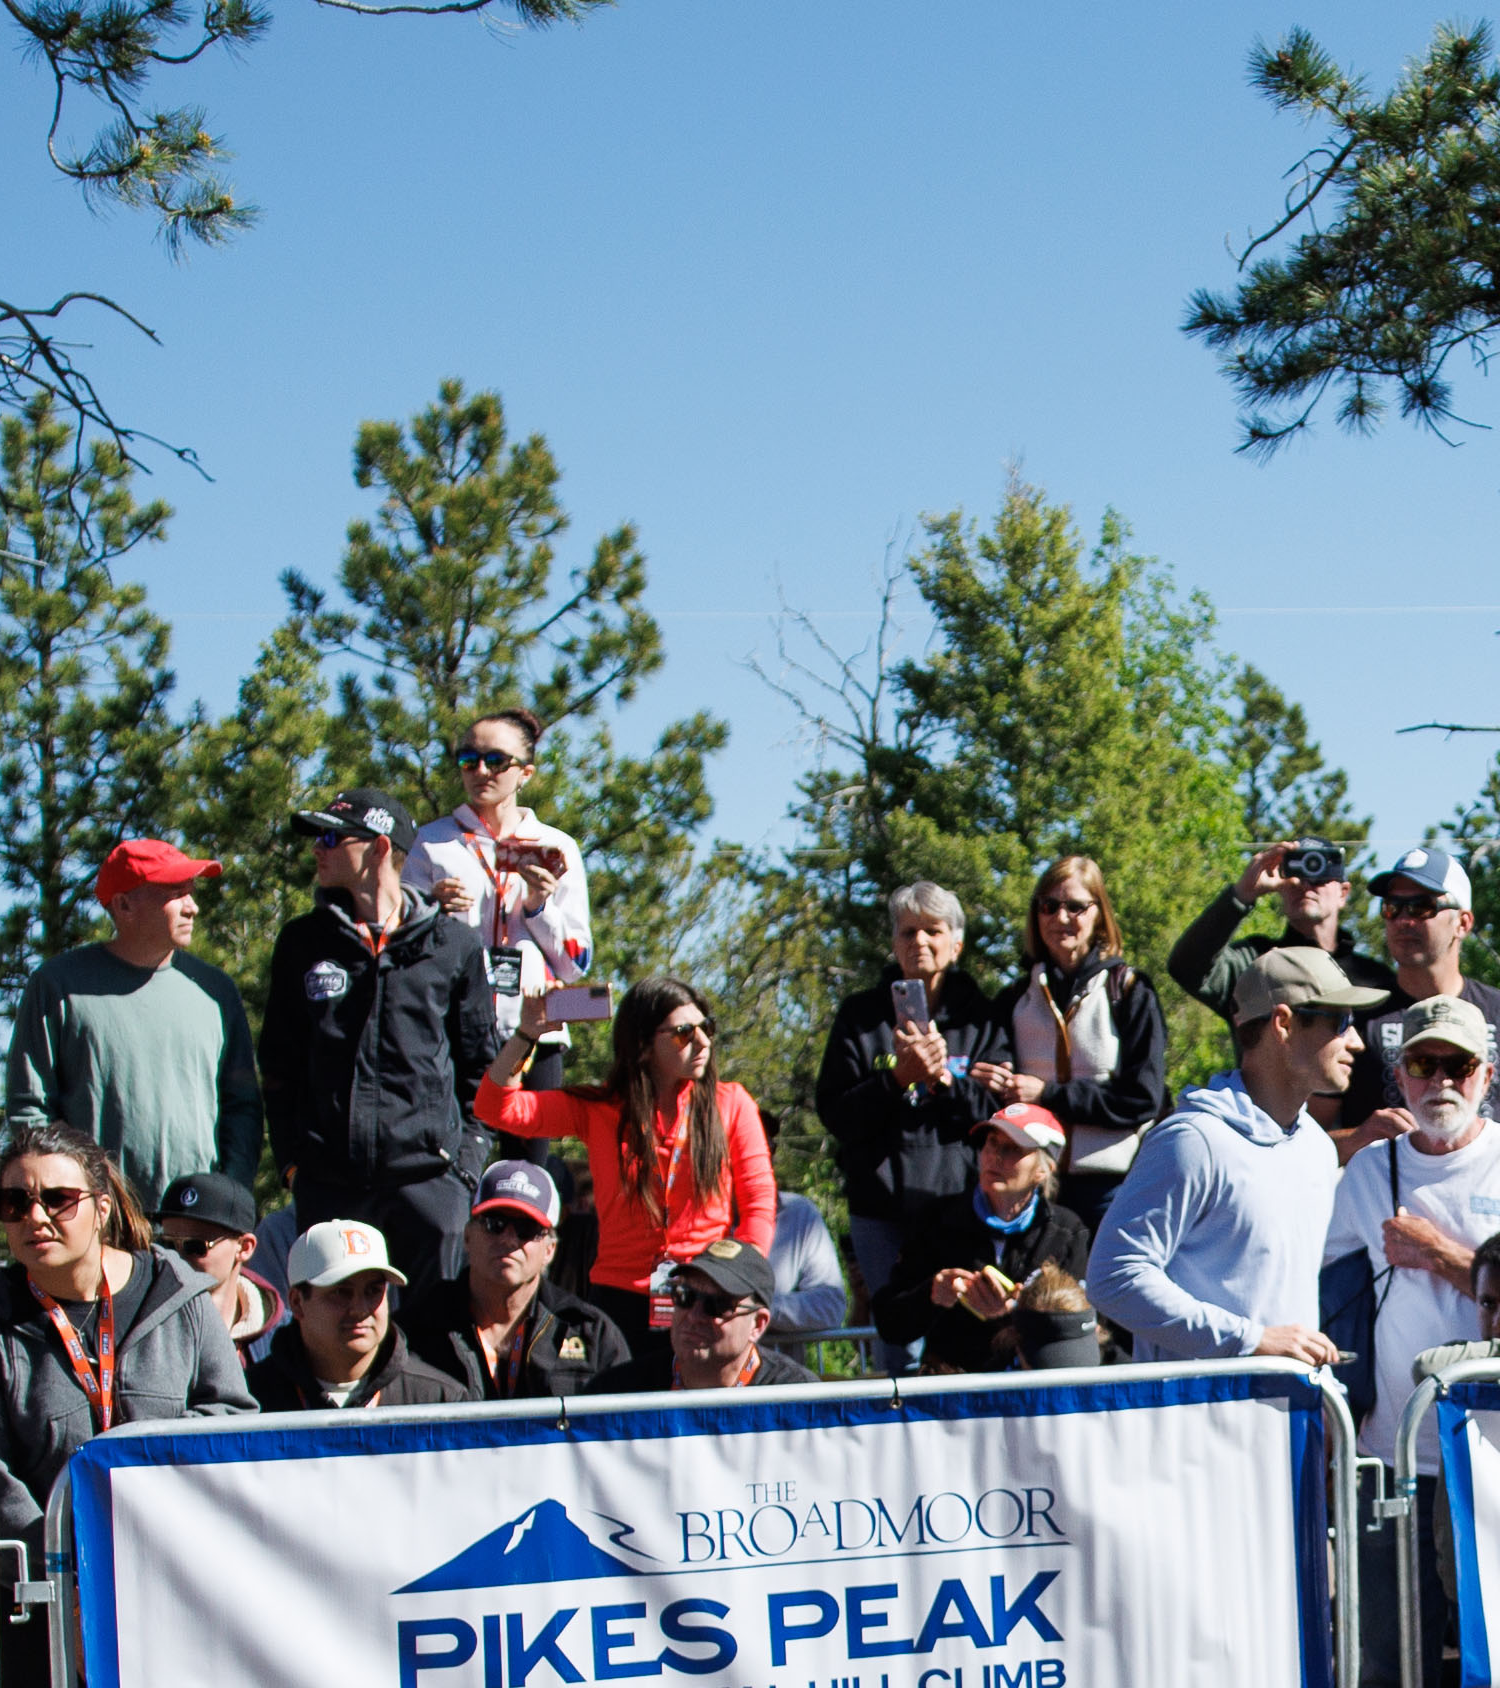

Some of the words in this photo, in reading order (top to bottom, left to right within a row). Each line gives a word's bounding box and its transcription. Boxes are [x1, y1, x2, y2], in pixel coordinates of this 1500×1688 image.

[678, 1487, 1066, 1563] BROADMOOR
[746, 1481, 798, 1504] THE
[768, 1570, 1064, 1667] PEAK
